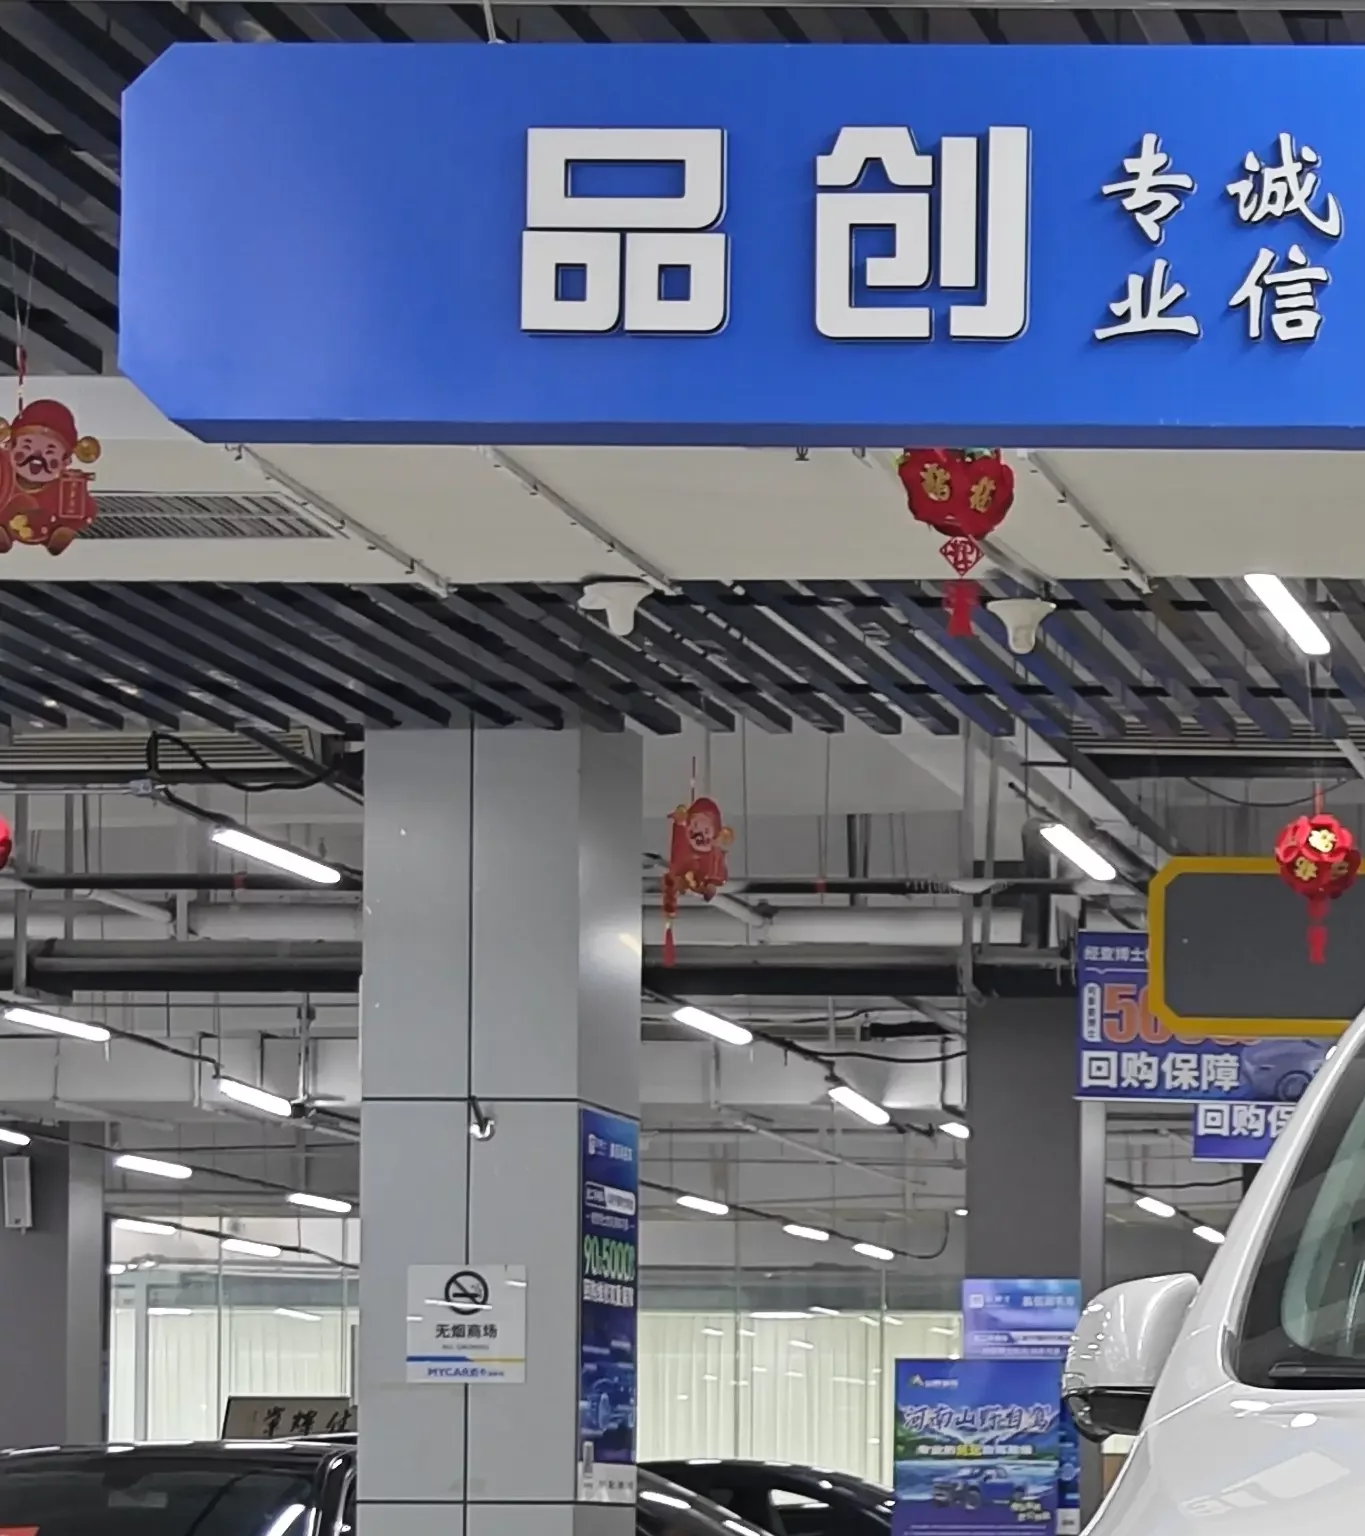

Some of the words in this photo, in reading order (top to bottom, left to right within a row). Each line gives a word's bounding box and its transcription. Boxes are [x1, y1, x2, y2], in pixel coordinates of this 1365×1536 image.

[521, 125, 1030, 338] 品创
[1081, 1050, 1240, 1093] 回购保障
[435, 1323, 498, 1339] 无烟商场
